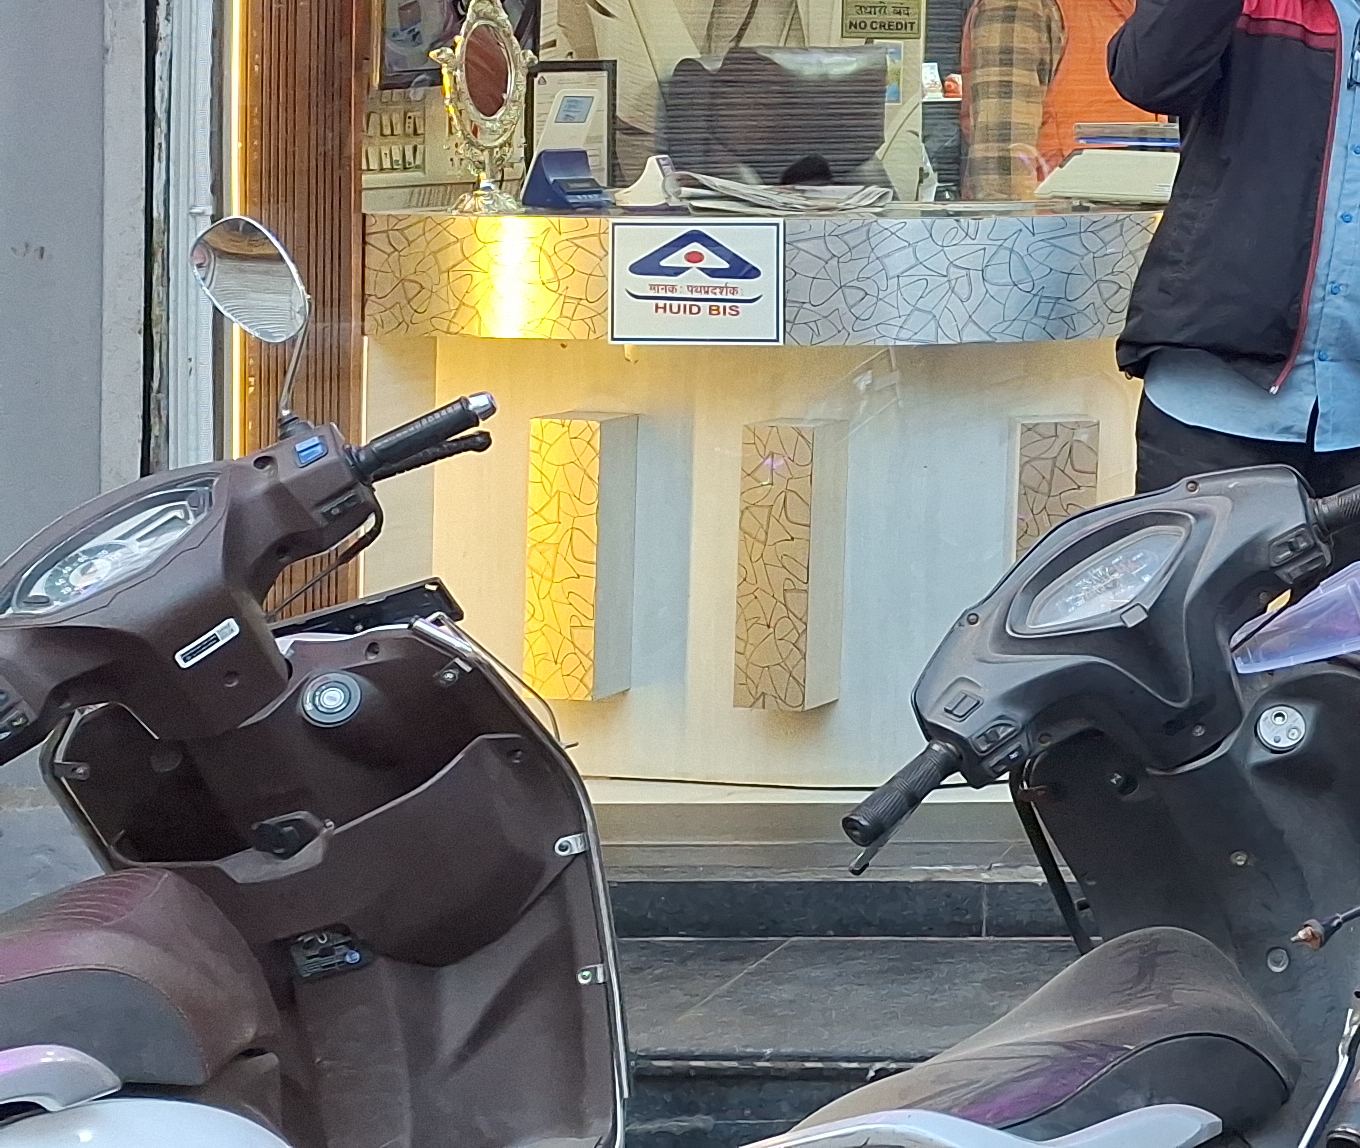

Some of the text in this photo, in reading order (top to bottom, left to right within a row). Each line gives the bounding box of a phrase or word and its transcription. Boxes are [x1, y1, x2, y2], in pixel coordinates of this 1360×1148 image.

[848, 20, 917, 32] NO CREDIT
[655, 303, 741, 317] HUID BIS
